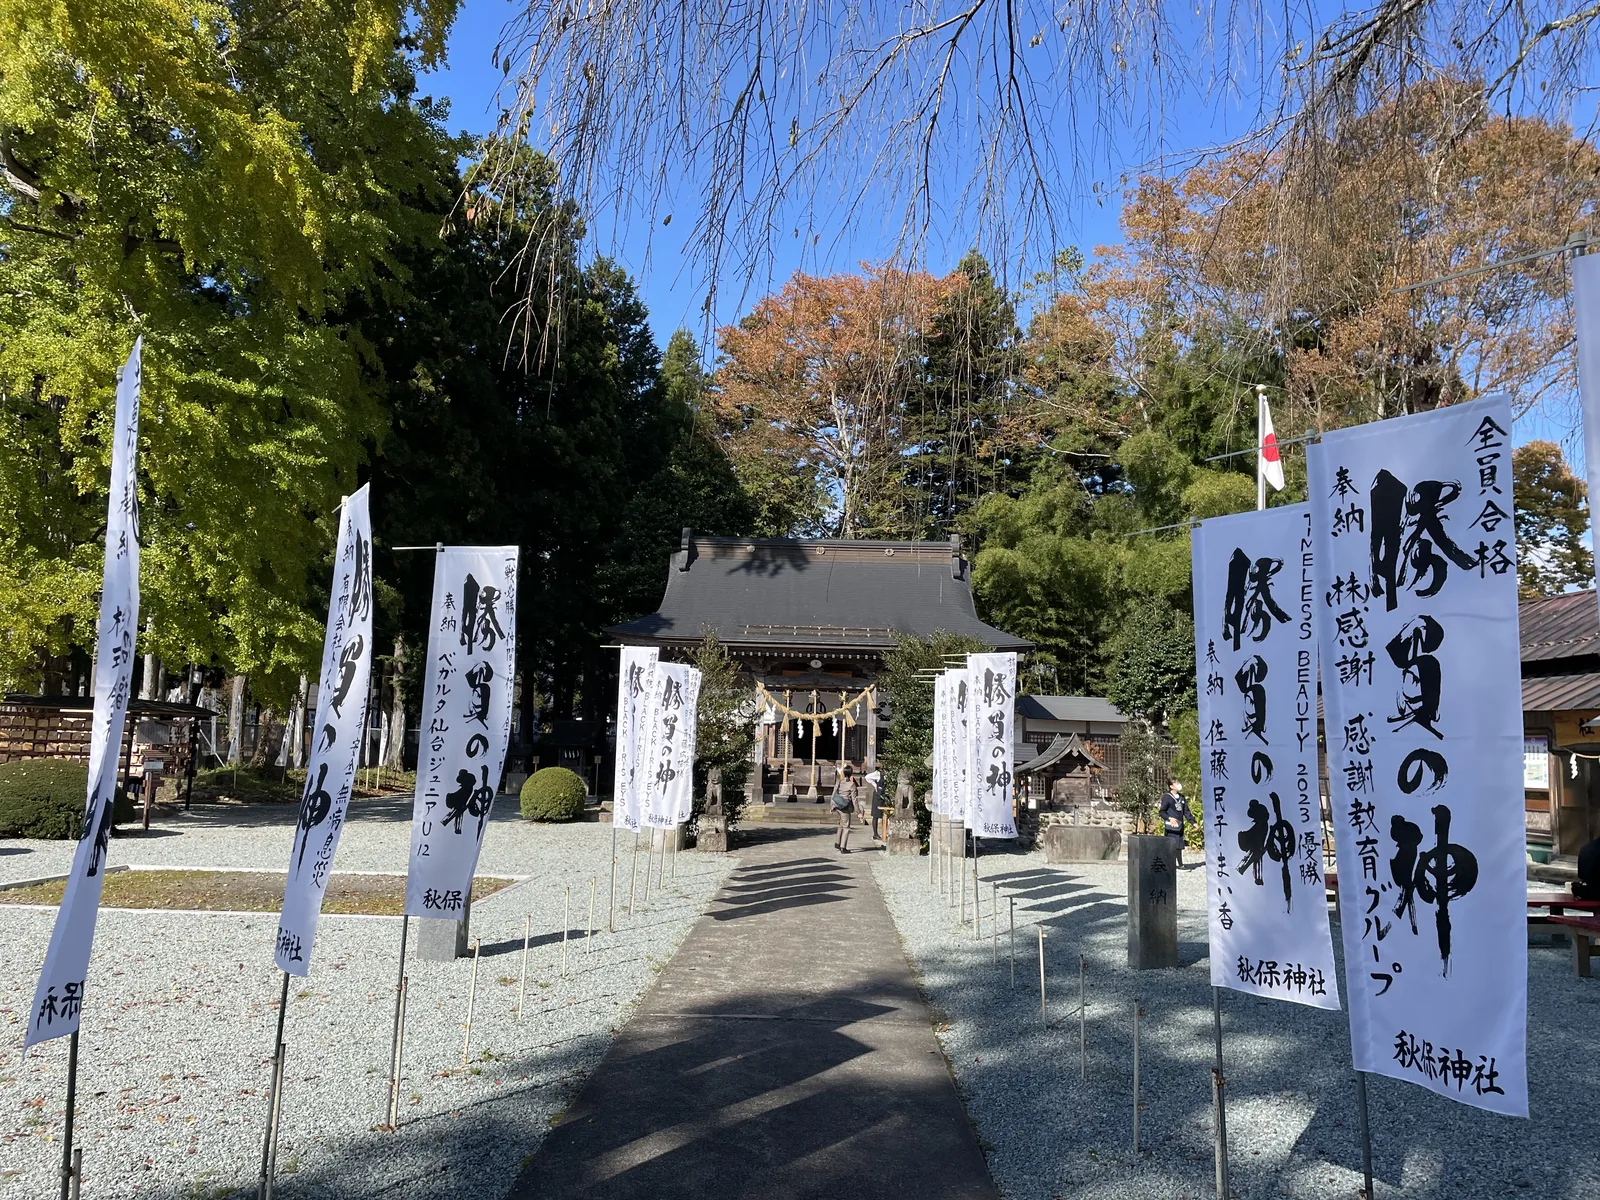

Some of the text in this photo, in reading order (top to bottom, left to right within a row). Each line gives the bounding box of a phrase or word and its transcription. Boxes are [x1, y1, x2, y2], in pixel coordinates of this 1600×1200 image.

[1328, 466, 1364, 539] 奉納
[1464, 415, 1516, 579] 全員合格
[440, 591, 456, 633] 奉納
[1204, 638, 1223, 696] 奉納
[440, 572, 505, 846] 勝負の神
[651, 708, 659, 746] BLACK
[974, 705, 982, 744] BLACK
[1222, 546, 1296, 915] 勝負の神
[1295, 650, 1309, 753] BEAUTY
[1369, 469, 1480, 980] 勝負の神
[654, 675, 684, 799] 勝負の神
[984, 667, 1012, 806] 勝負の神
[1297, 763, 1311, 824] 2023
[982, 822, 1014, 835] 秋保神社
[1297, 831, 1322, 887] 優勝
[1342, 713, 1403, 998] 感謝教育グループ
[1149, 856, 1168, 905] 奉納
[1236, 954, 1327, 996] 秋保神社
[1393, 1030, 1506, 1097] 秋保神社
